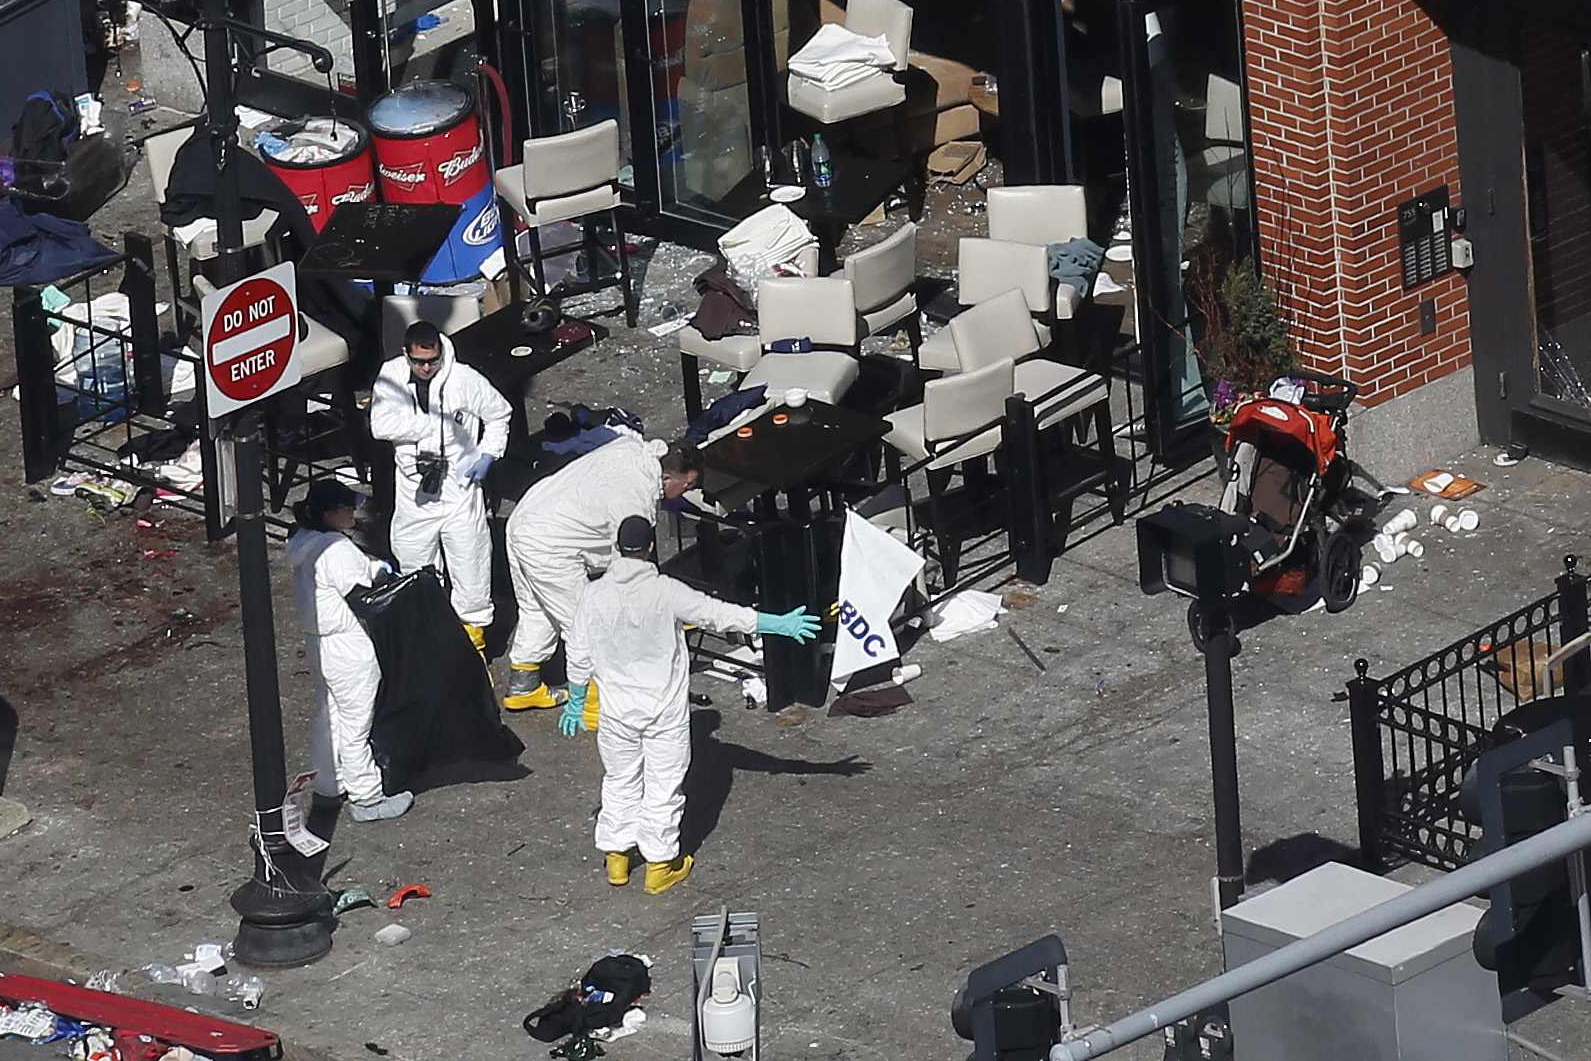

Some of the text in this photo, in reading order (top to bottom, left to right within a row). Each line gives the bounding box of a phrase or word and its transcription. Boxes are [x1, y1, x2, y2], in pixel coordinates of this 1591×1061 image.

[223, 295, 276, 333] DO NOT
[231, 349, 275, 382] ENTER
